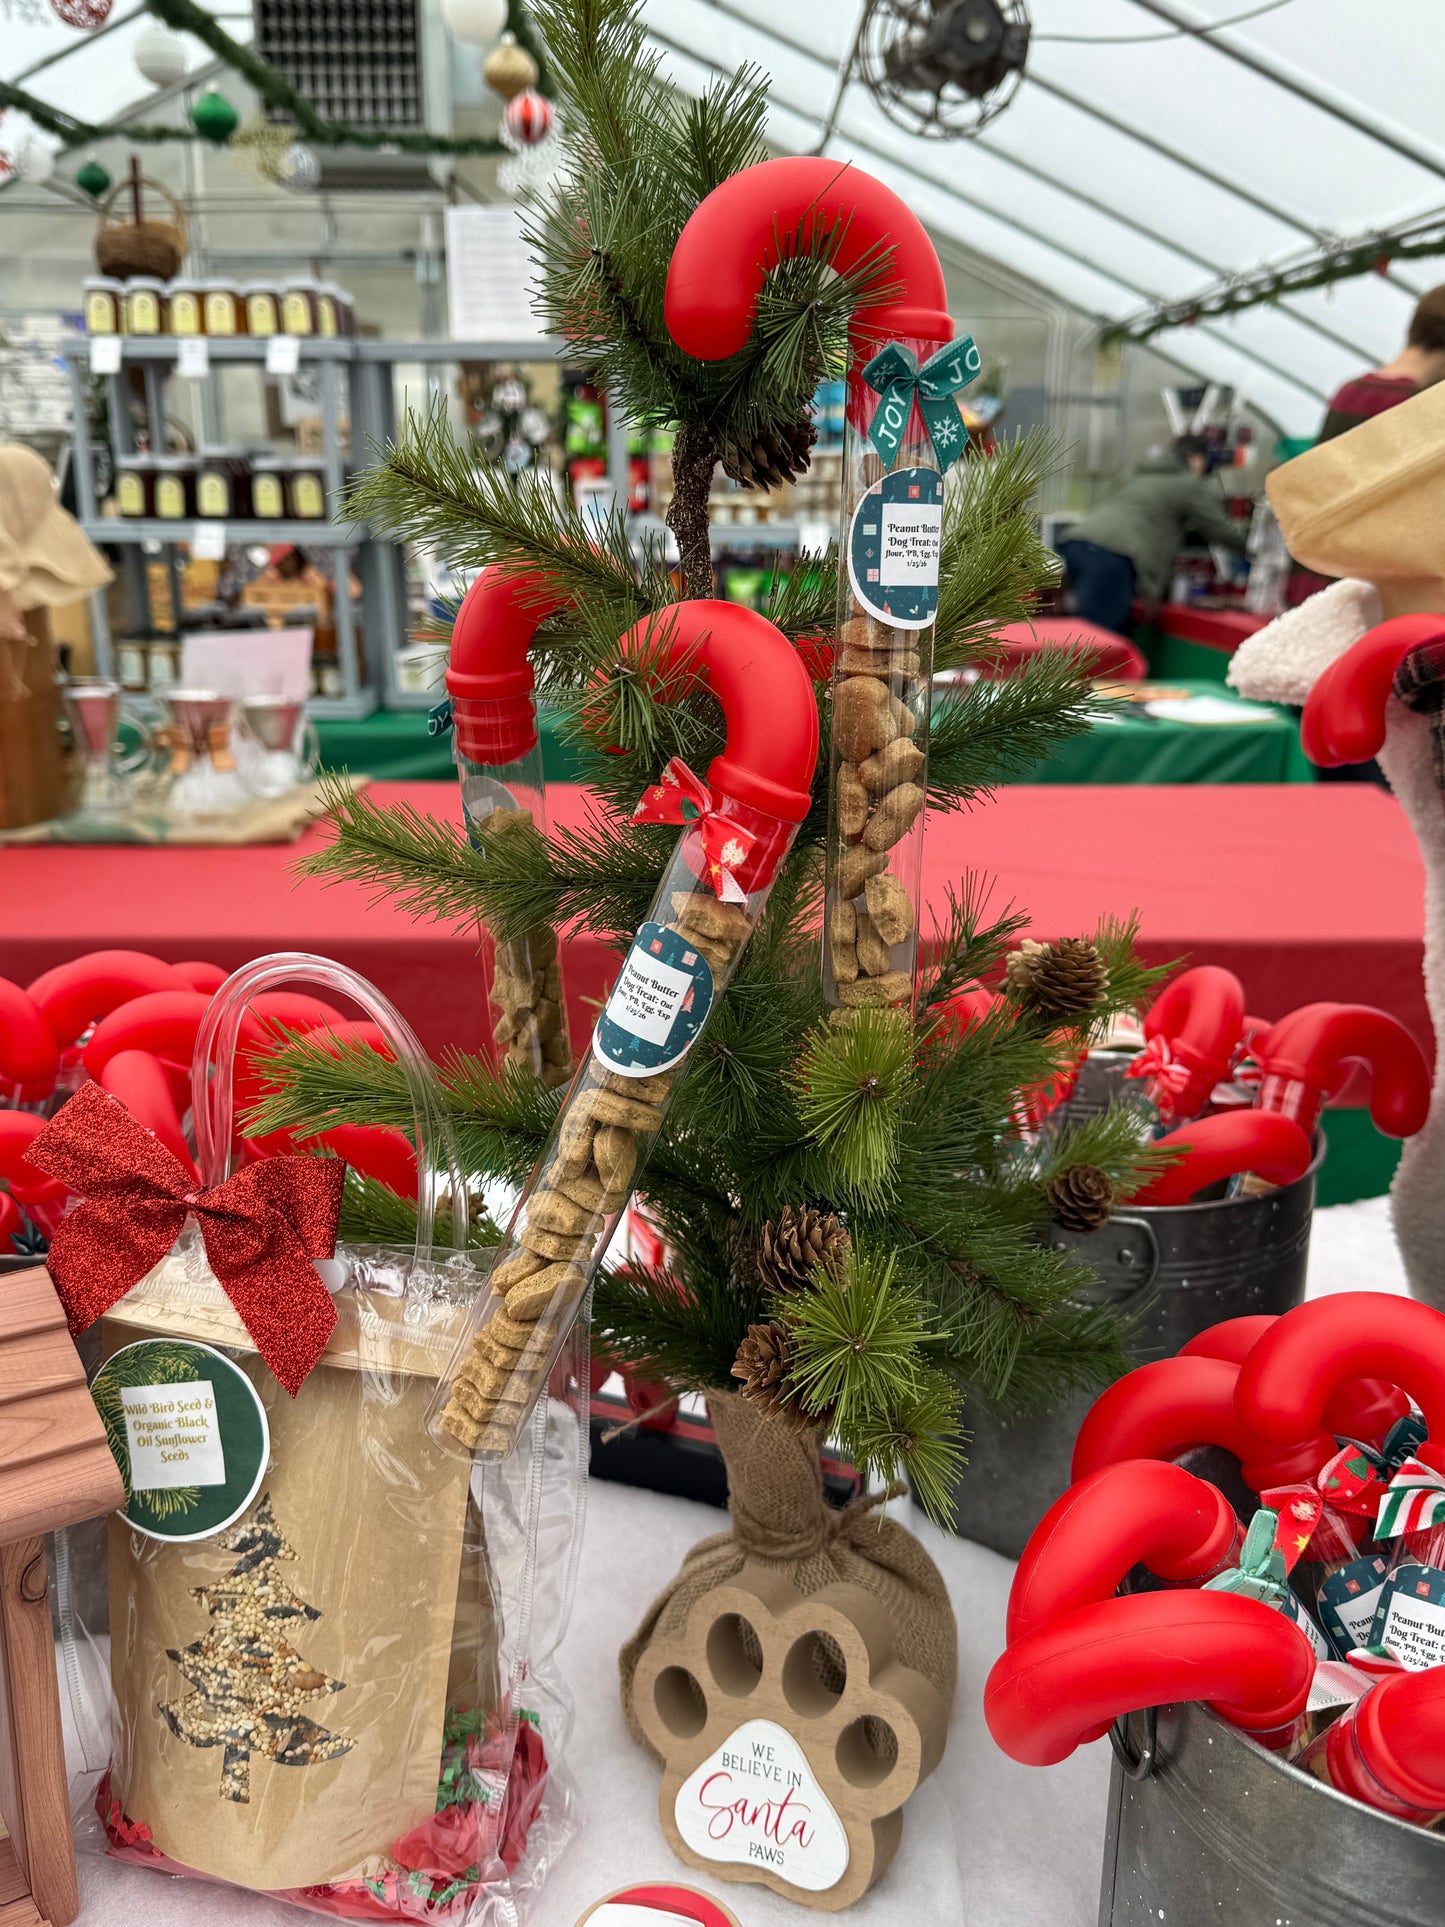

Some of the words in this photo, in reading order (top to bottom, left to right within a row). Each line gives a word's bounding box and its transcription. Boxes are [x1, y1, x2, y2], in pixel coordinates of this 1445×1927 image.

[877, 386, 906, 449] JOY
[887, 523, 919, 533] Peanut
[887, 536, 909, 549] Dog
[909, 536, 931, 547] Treat:
[883, 549, 905, 559] flour,
[905, 549, 919, 558] PB,
[906, 559, 928, 569] 1/25/26
[628, 964, 650, 984] Peanut
[651, 979, 679, 998] Butter
[623, 976, 635, 992] Dog
[636, 985, 659, 1004] Treat:
[660, 1000, 674, 1010] Oat
[626, 1005, 647, 1019] 1/25/26
[629, 995, 639, 1007] PB,
[657, 1009, 671, 1021] Exp
[123, 1402, 148, 1416] Wild
[149, 1400, 175, 1414] Bird
[177, 1398, 202, 1413] Seed
[204, 1397, 214, 1409] &
[132, 1419, 173, 1433] Organic
[175, 1414, 210, 1429] Black
[136, 1435, 153, 1448] Oil
[154, 1433, 208, 1449] Sunflower
[160, 1448, 190, 1464] Seeds
[1392, 1611, 1425, 1630] Peanut
[1389, 1624, 1409, 1641] Dog
[1409, 1631, 1439, 1650] Treat:
[1403, 1642, 1419, 1656] PB,
[1402, 1654, 1429, 1669] 1/25/26
[751, 1741, 776, 1763] WE
[721, 1752, 782, 1782] BELIEVE
[786, 1769, 803, 1788] IN
[699, 1771, 815, 1848] Santa
[748, 1841, 786, 1866] PAWS
